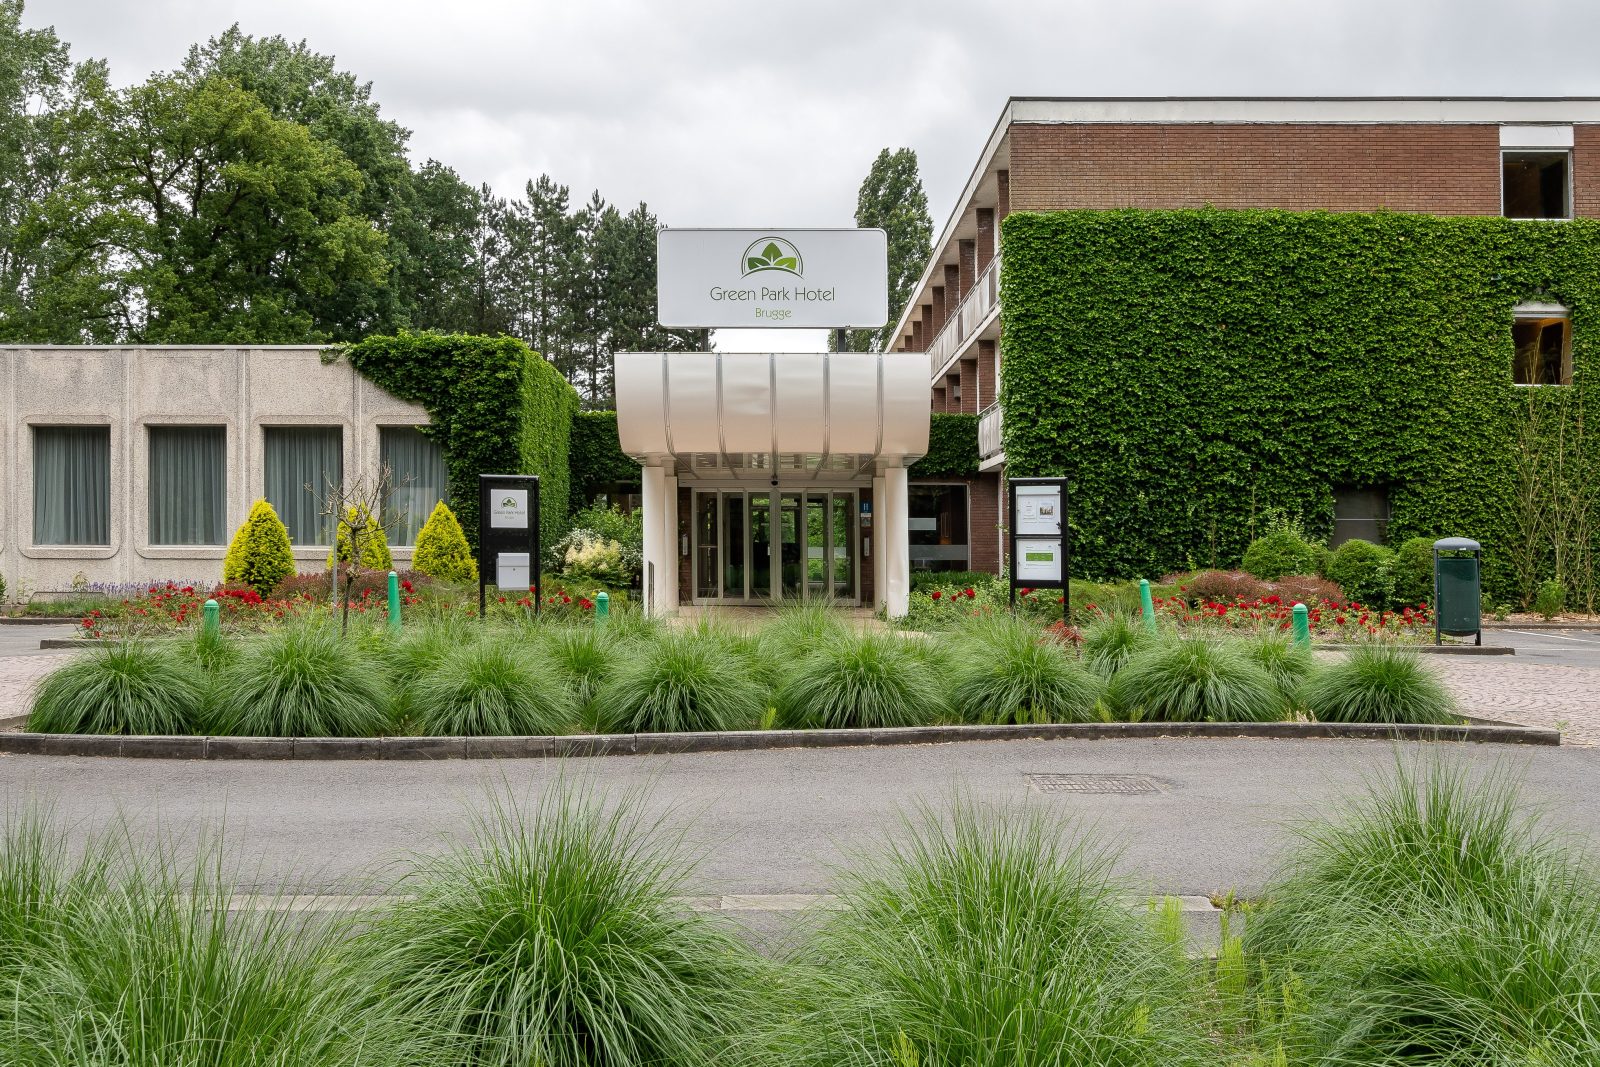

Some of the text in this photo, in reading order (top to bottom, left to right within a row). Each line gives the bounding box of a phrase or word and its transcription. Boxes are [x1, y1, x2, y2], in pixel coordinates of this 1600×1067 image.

[710, 286, 835, 301] Green Park Hotel
[755, 307, 792, 320] Brugge
